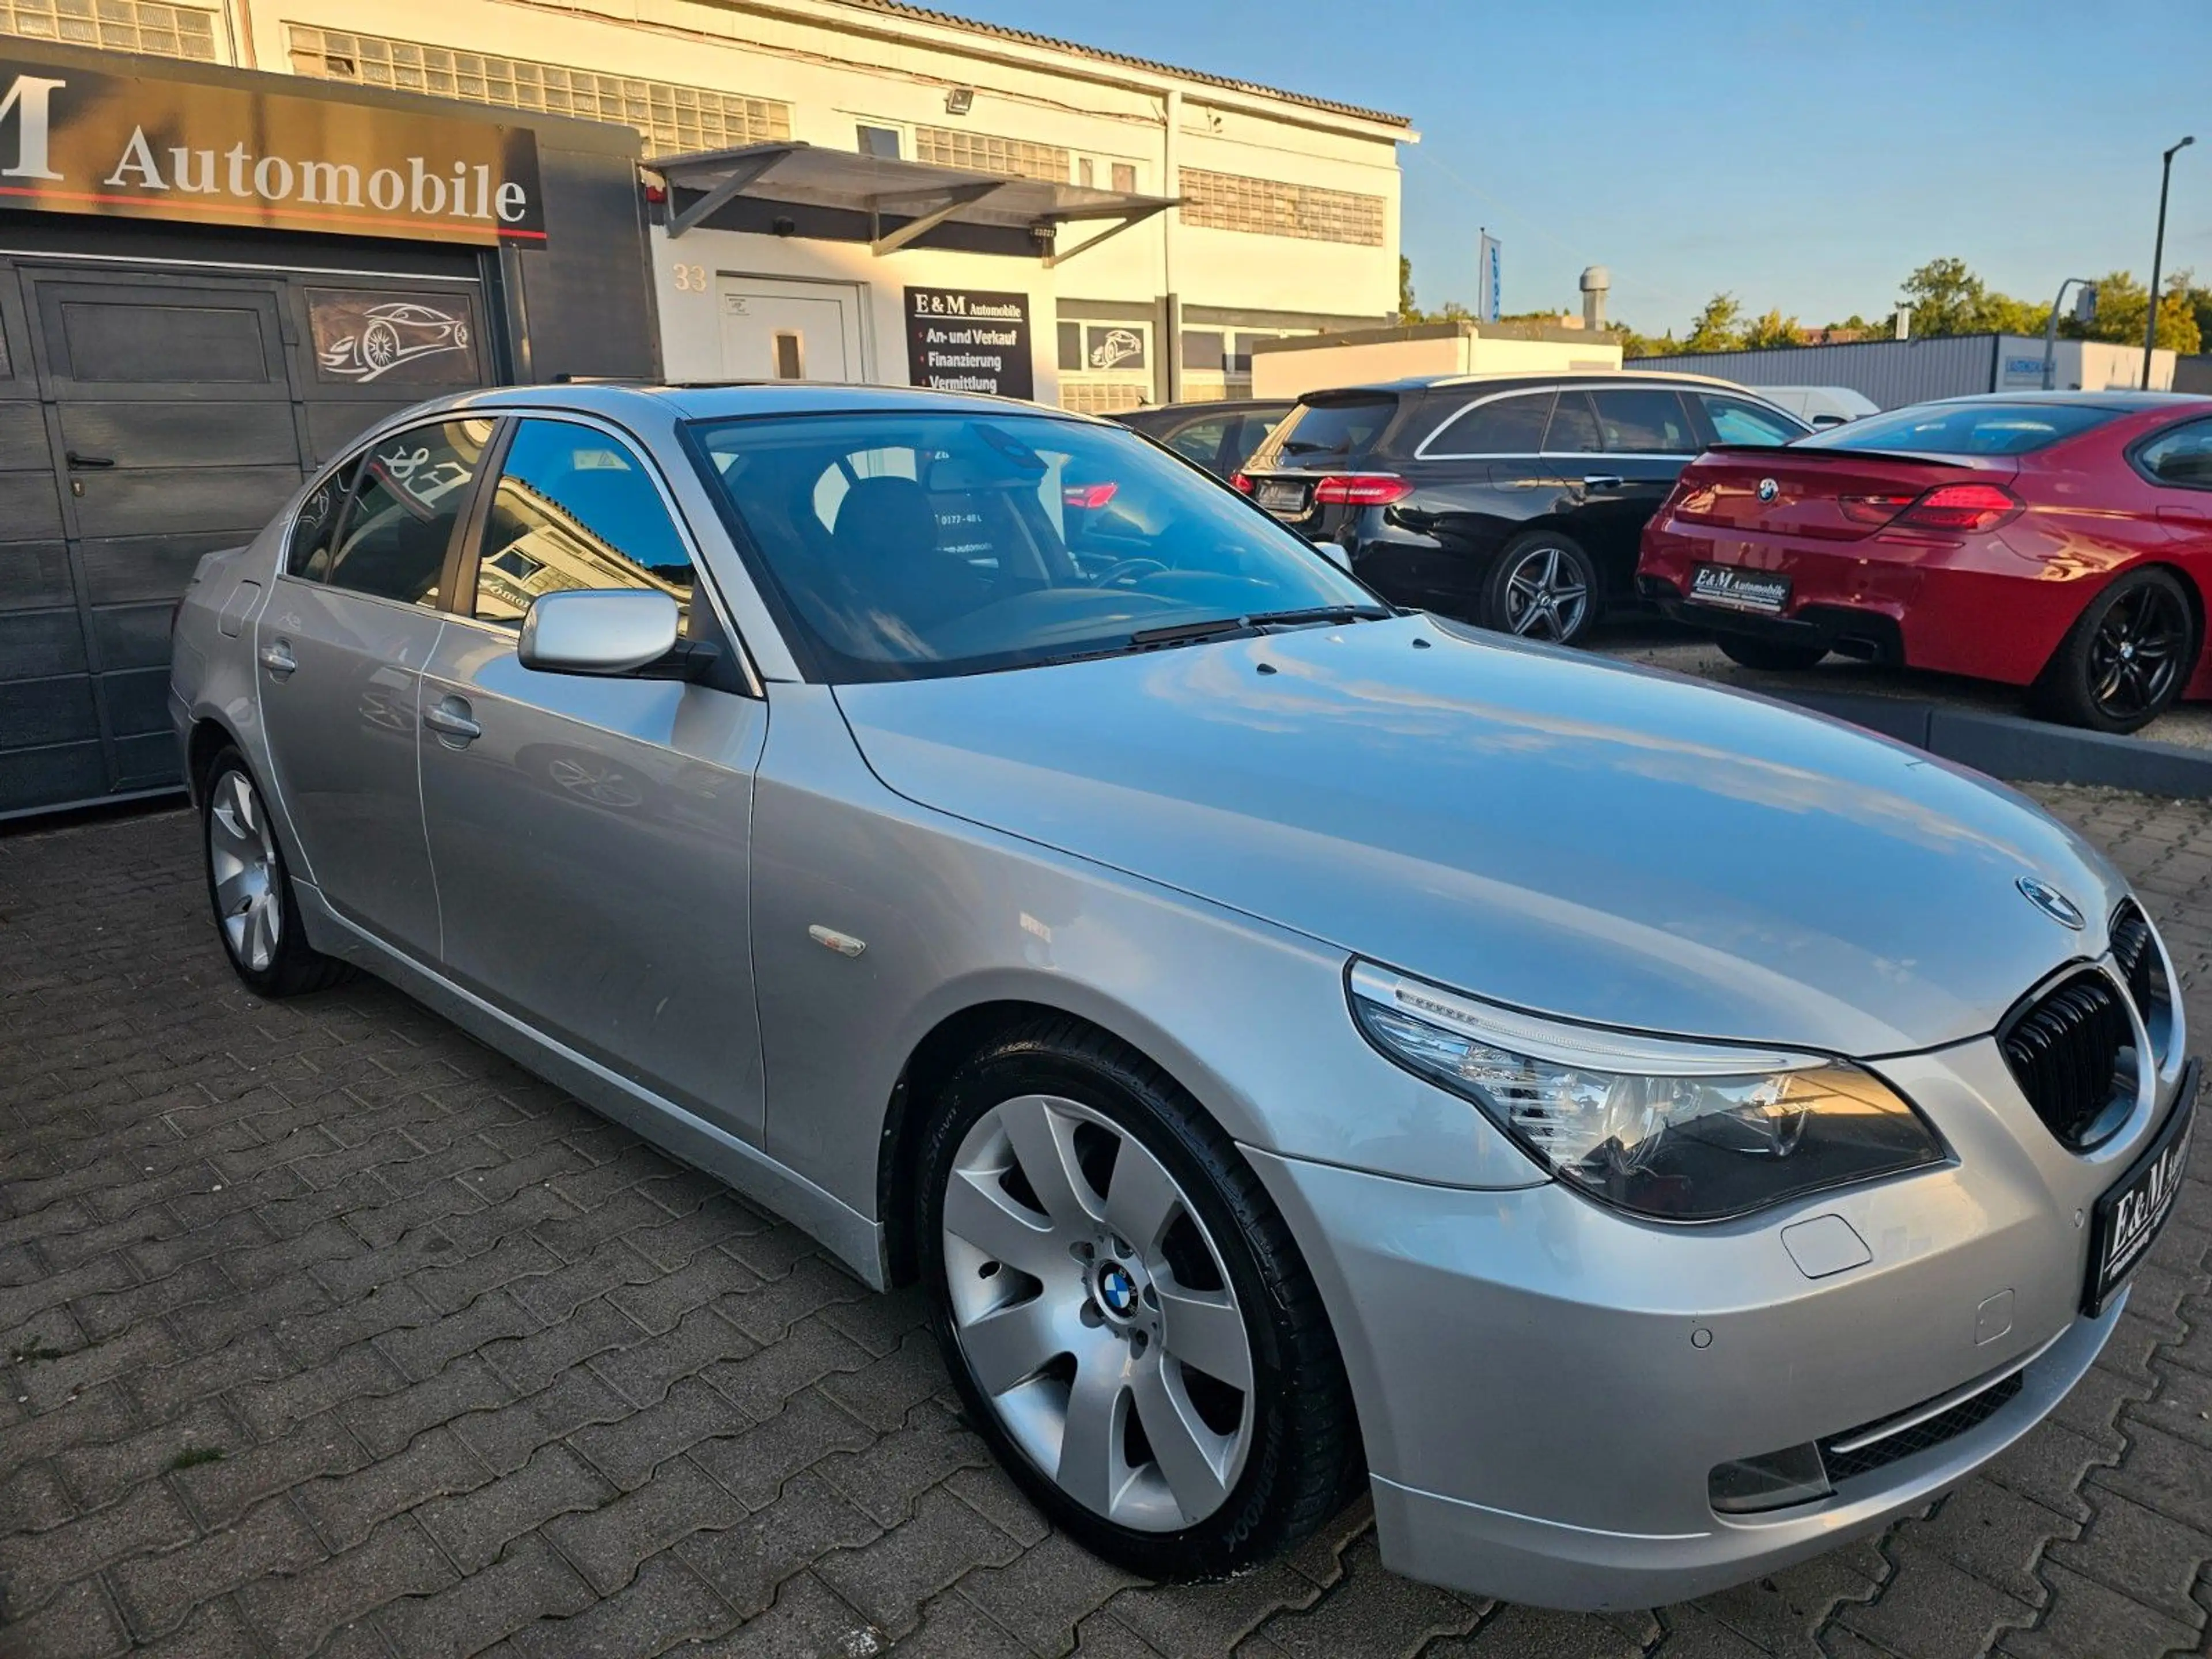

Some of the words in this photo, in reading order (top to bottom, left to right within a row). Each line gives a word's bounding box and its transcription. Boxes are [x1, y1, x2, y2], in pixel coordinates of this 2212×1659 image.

[103, 124, 527, 224] Automobile
[673, 263, 707, 292] 33
[969, 303, 1021, 317] Automobile
[926, 328, 947, 343] An-
[949, 329, 971, 344] und
[972, 329, 1017, 346] Verkauf
[928, 351, 1002, 372] Finanzierung
[929, 375, 997, 394] Vermittlung
